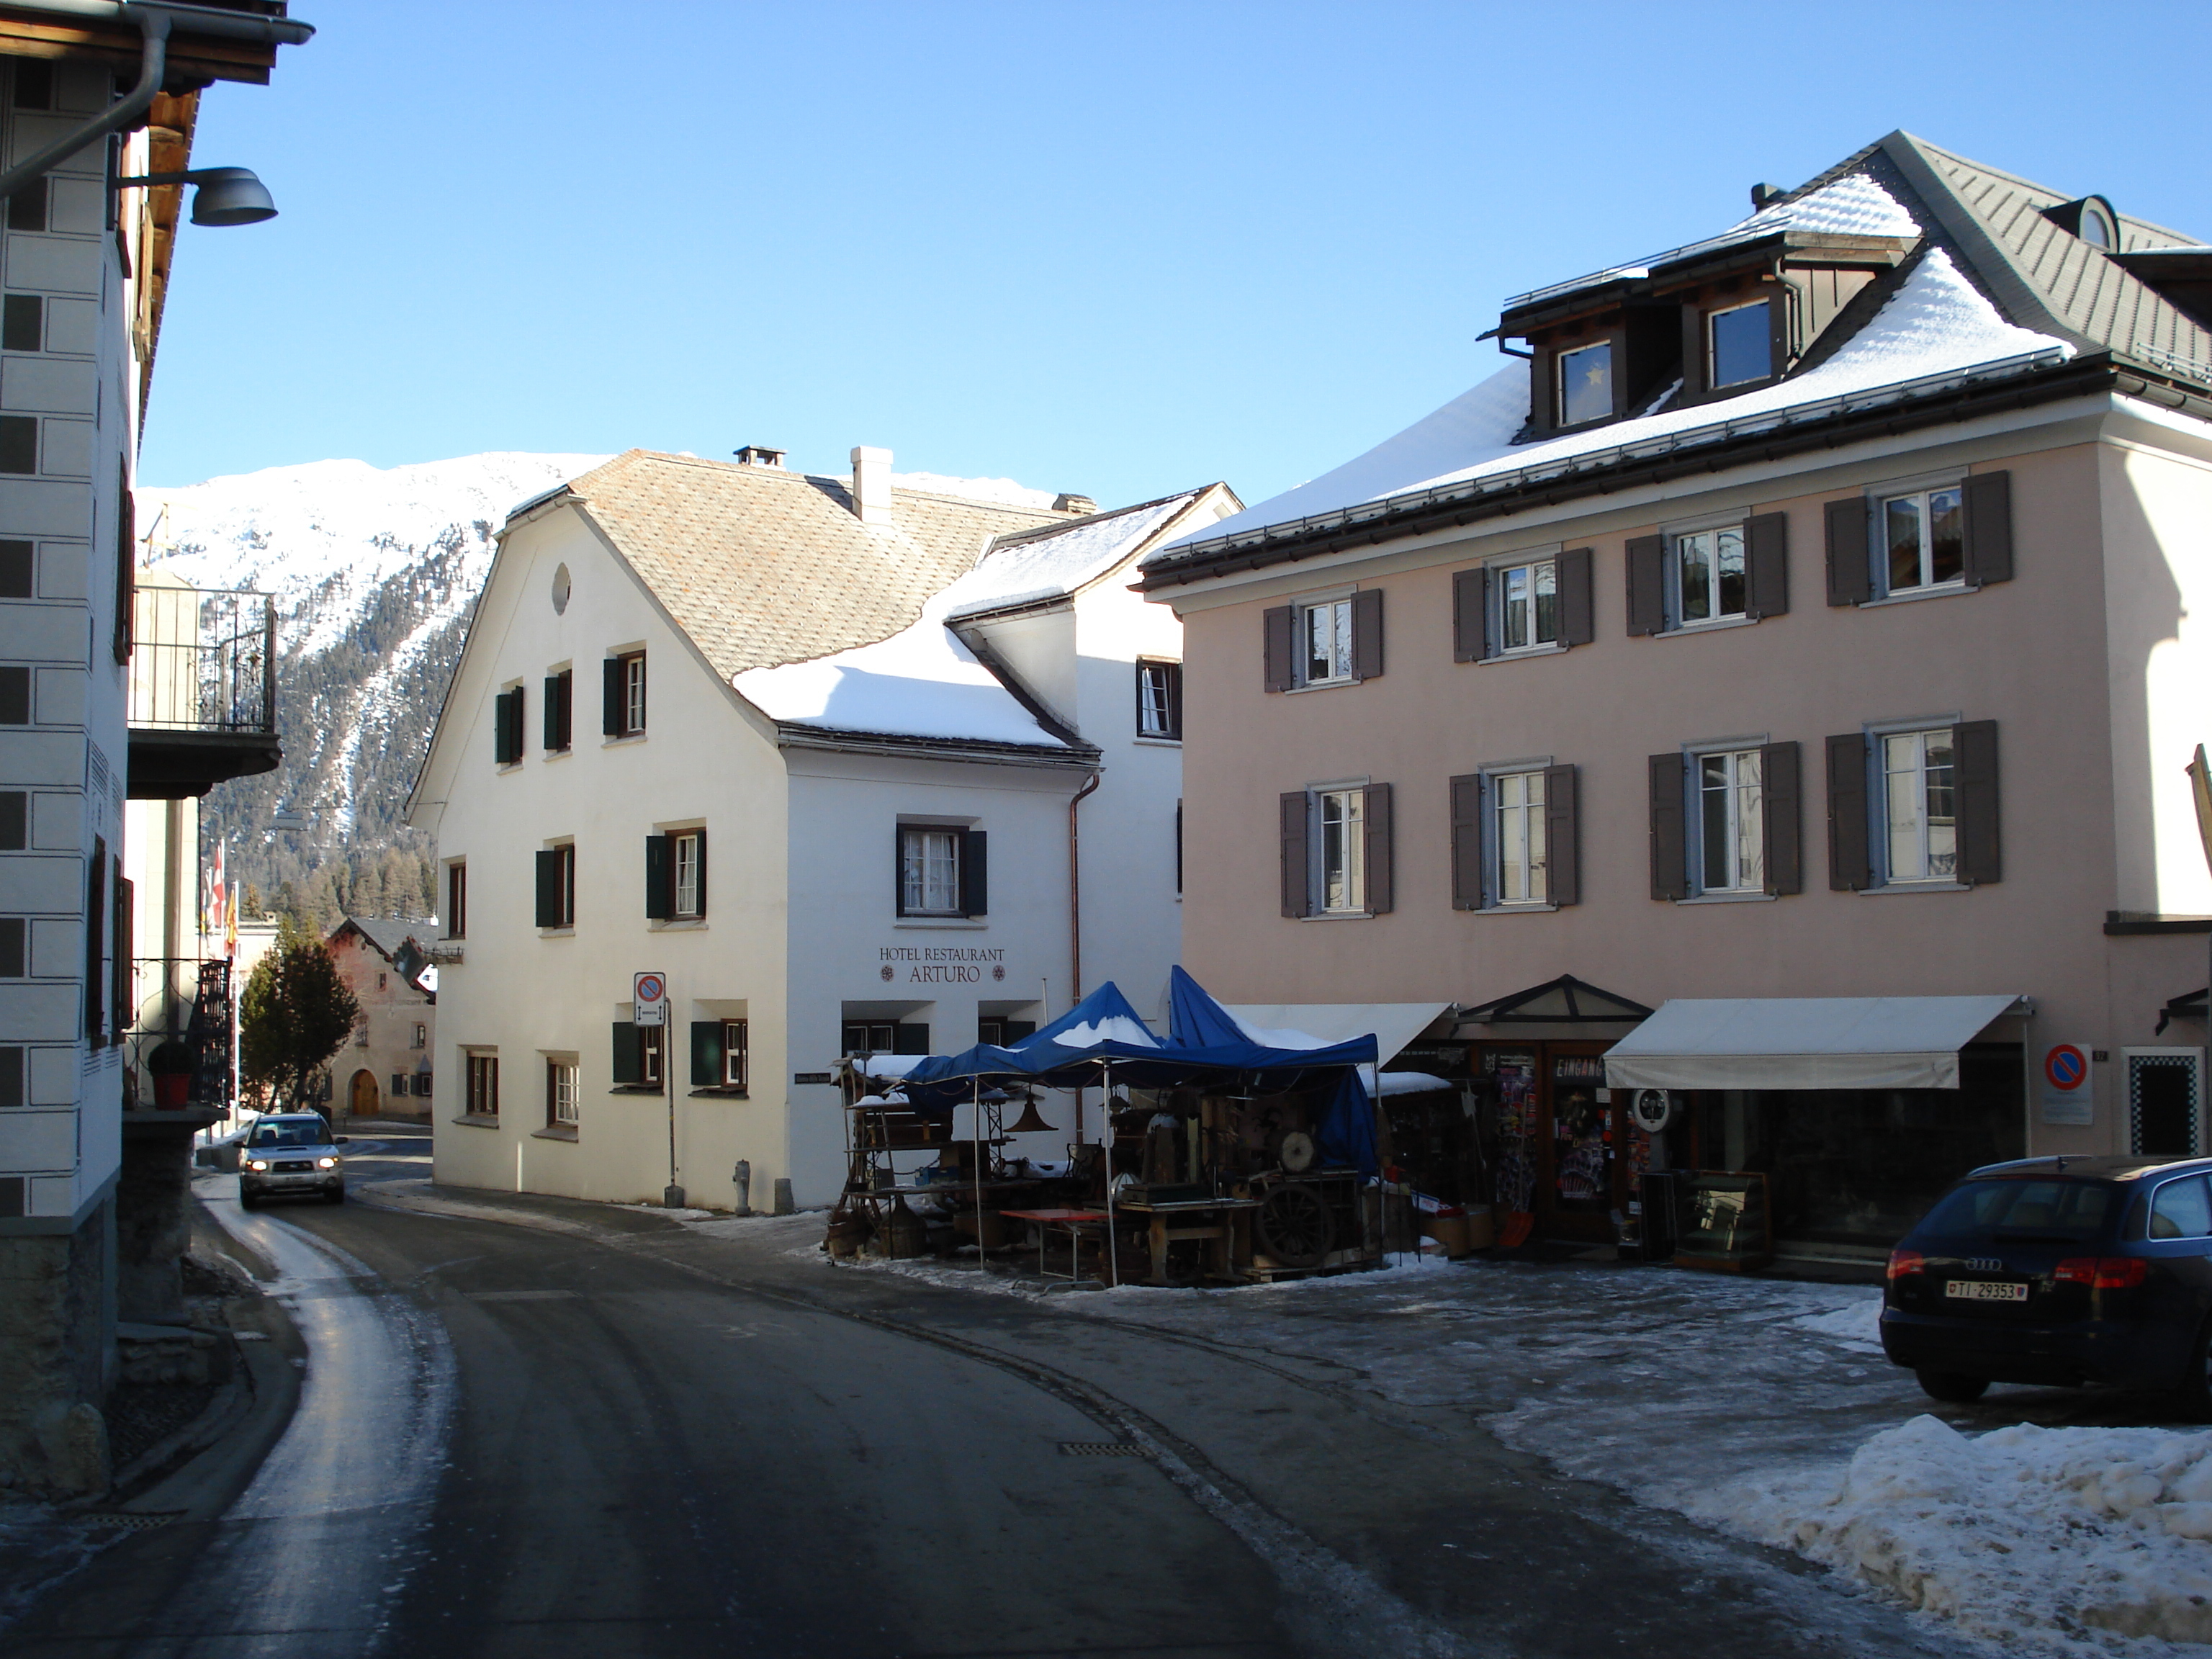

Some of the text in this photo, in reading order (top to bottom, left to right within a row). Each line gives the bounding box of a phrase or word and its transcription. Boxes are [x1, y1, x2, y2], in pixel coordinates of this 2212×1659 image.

[879, 948, 1004, 961] HOTEL RESTAURANT
[909, 966, 981, 983] ARTURO
[1556, 1058, 1603, 1077] EINGANG
[1959, 1282, 2015, 1298] TI 29353
